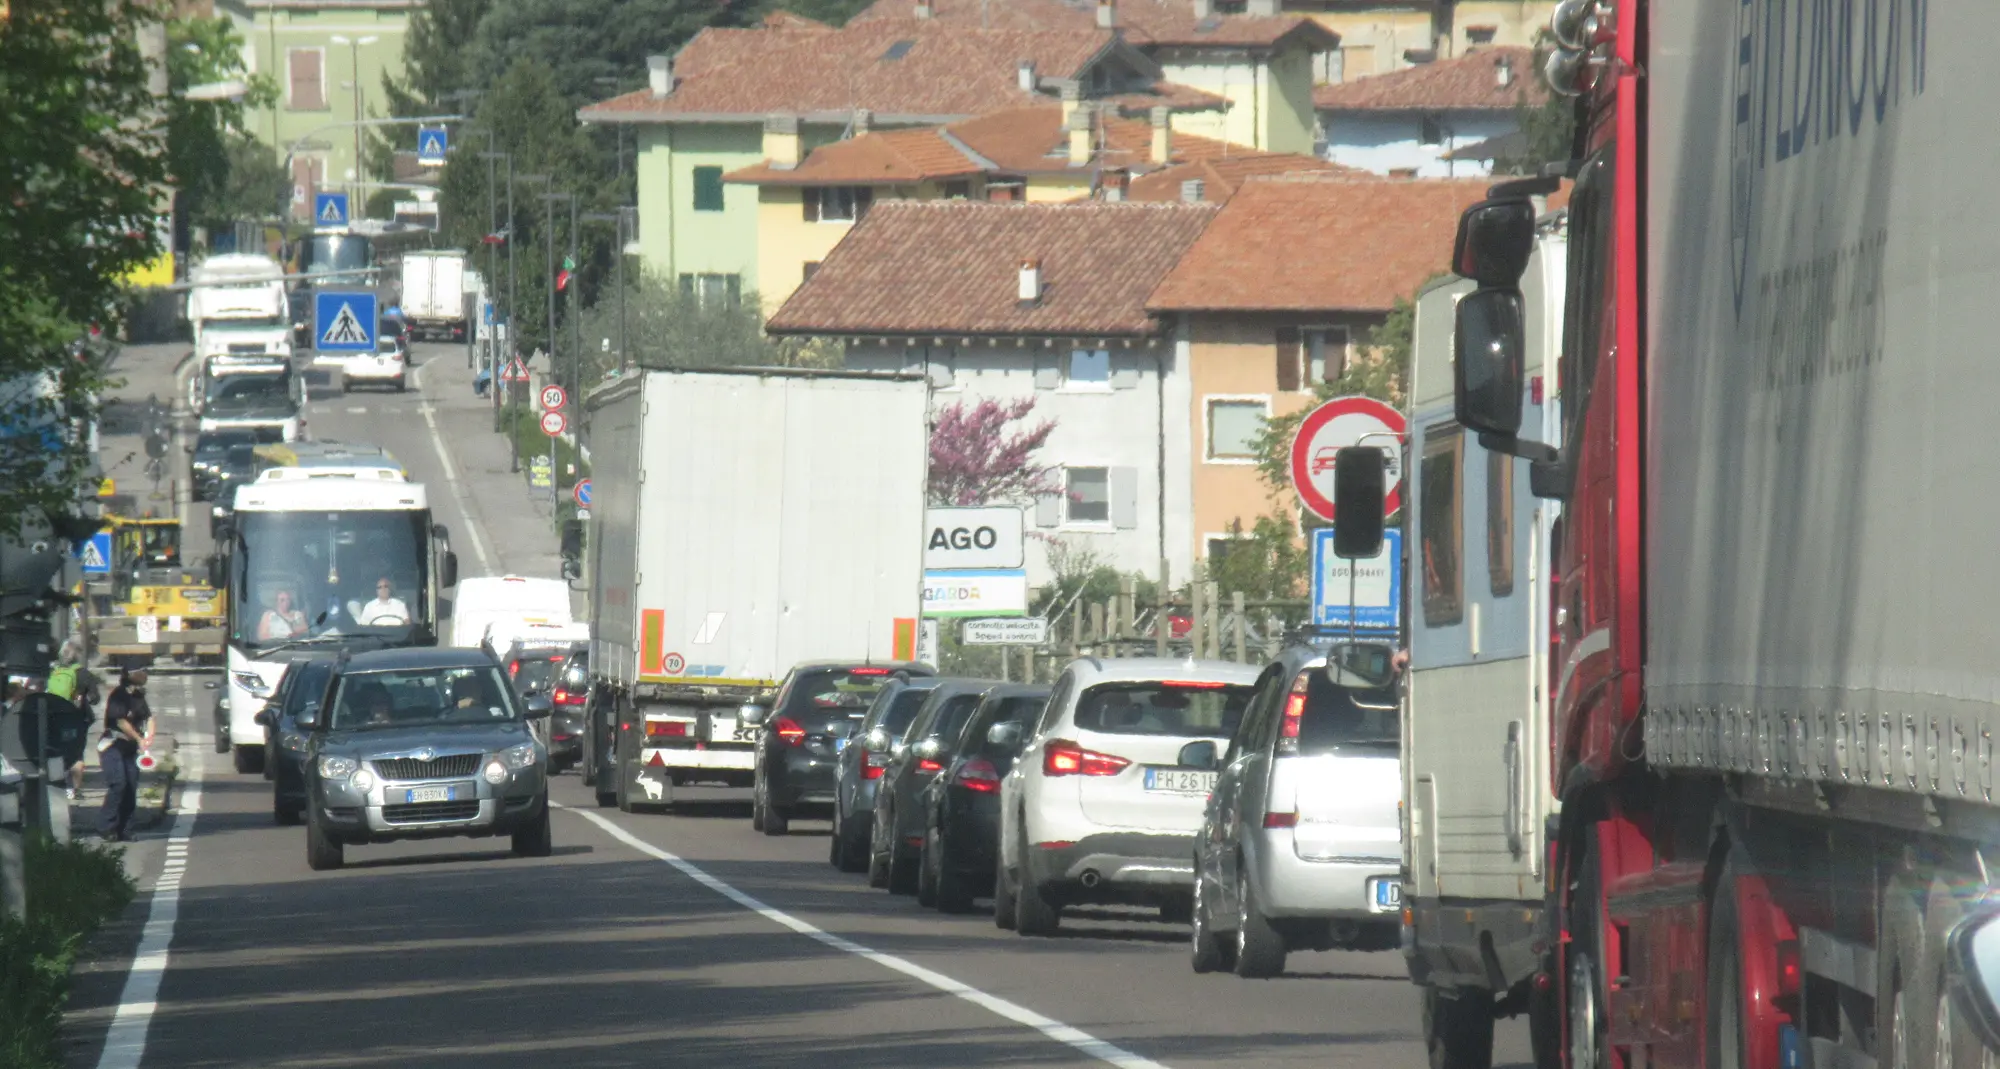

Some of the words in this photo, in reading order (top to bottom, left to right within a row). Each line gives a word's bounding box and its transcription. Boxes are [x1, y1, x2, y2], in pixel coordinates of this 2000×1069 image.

[546, 391, 560, 404] 50
[928, 526, 997, 551] AGO
[669, 658, 679, 668] 70
